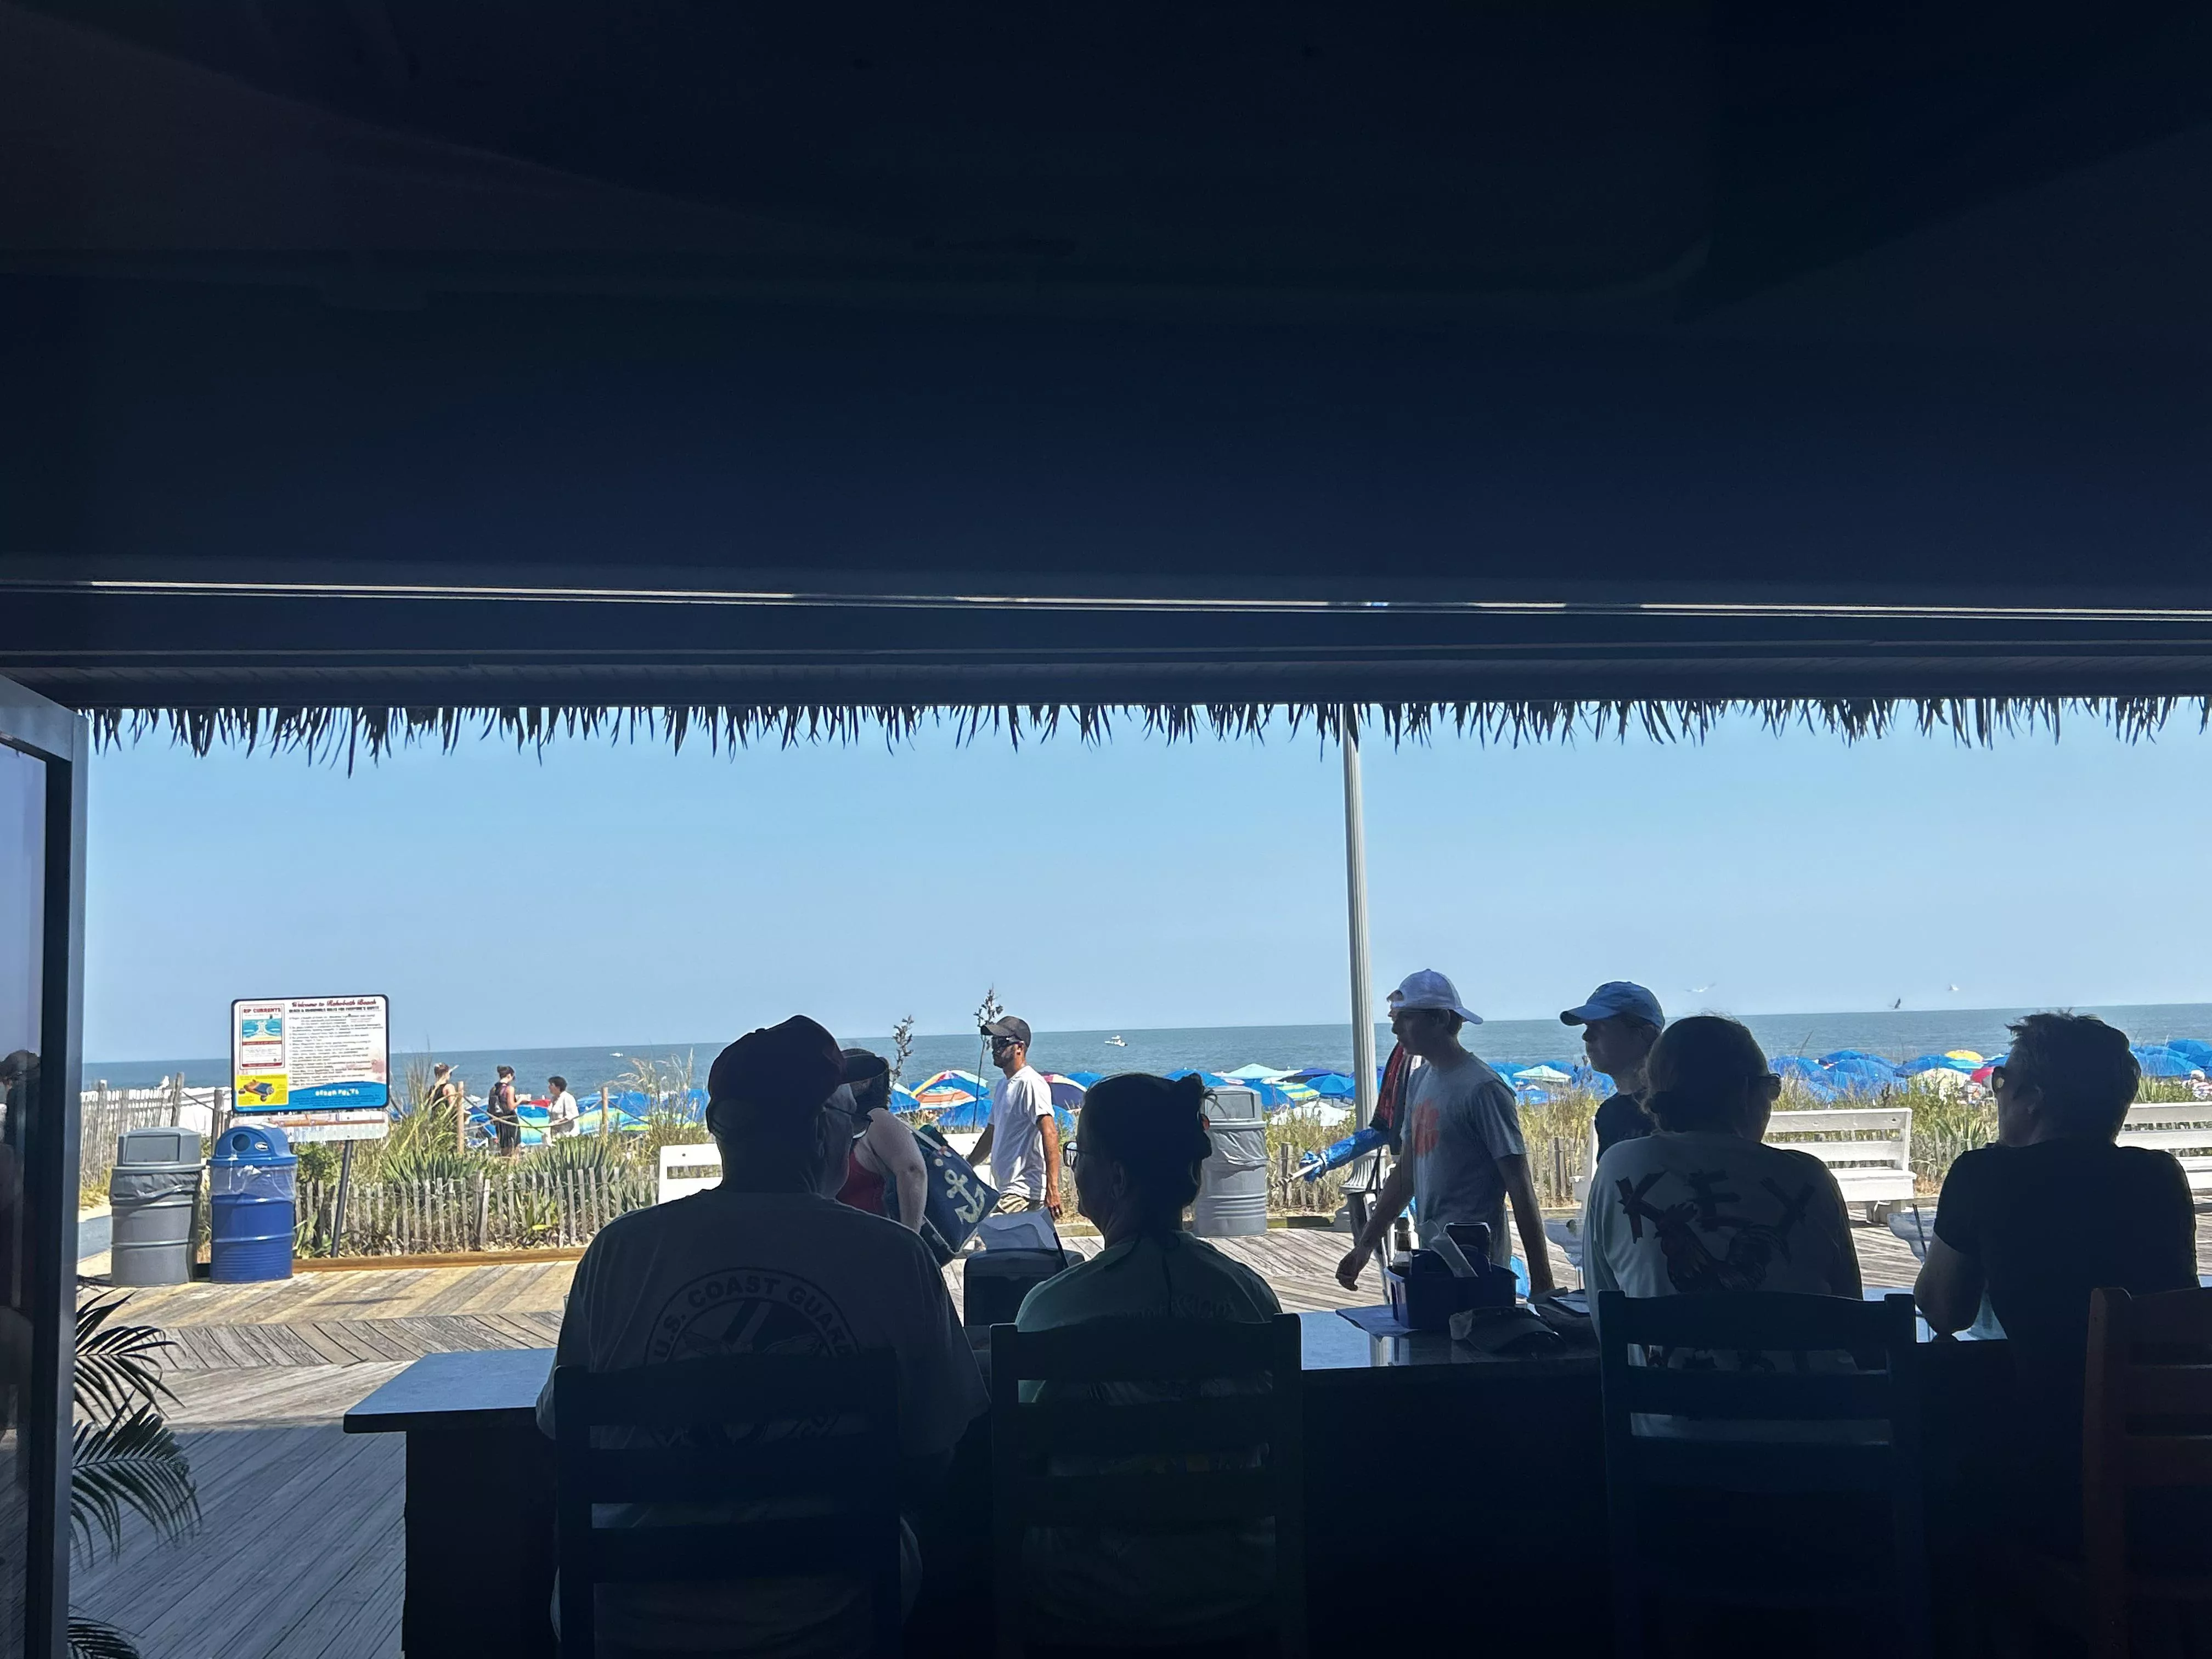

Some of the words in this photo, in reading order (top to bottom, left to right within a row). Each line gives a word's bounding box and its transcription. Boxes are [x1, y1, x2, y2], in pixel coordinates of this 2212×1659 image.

[1616, 1169, 1815, 1244] KEY
[653, 1313, 687, 1358] U.S.
[687, 1275, 781, 1308] COAST
